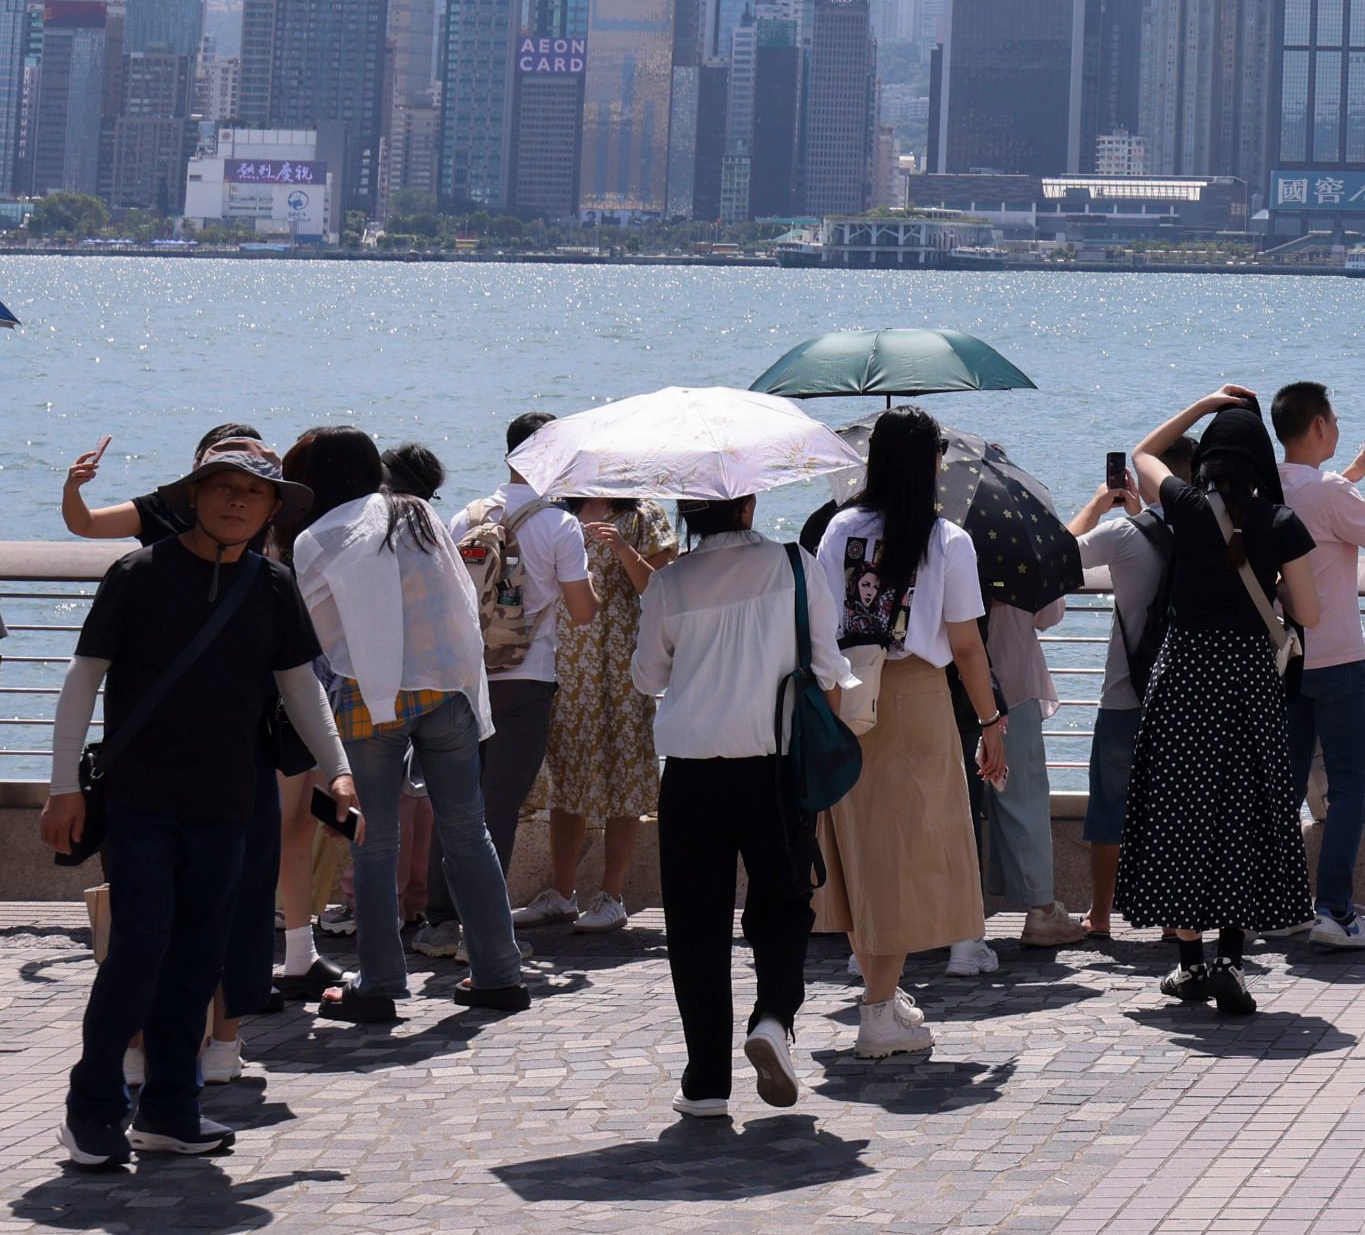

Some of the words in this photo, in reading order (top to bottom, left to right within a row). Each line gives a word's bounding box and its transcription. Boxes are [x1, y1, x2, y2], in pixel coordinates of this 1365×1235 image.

[520, 38, 585, 55] AEON
[519, 56, 584, 73] CARD
[1277, 176, 1345, 206] 國窖
